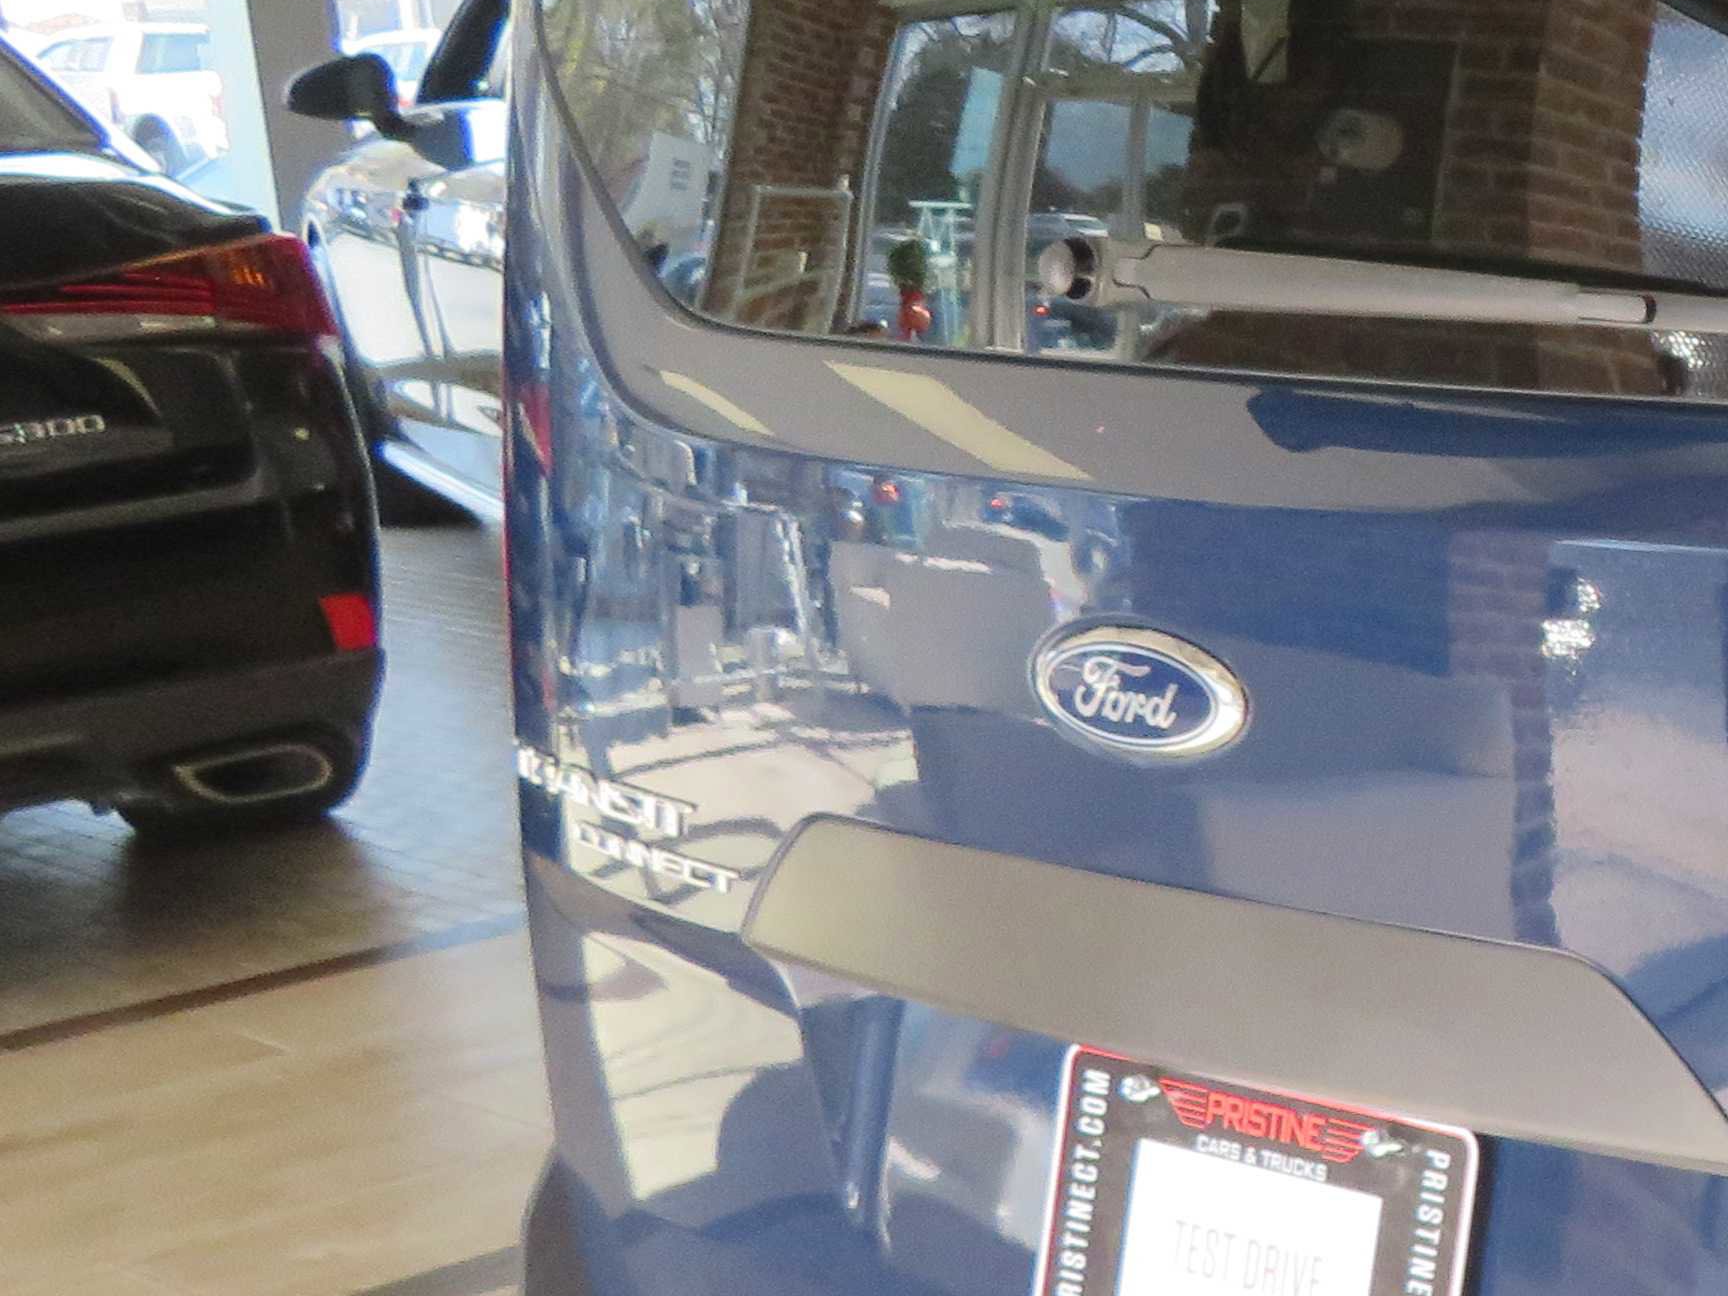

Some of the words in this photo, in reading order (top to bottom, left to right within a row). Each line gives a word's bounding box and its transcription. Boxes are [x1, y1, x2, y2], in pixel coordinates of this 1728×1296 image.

[1072, 655, 1179, 730] Ford
[576, 821, 741, 894] CONNECT
[1205, 1090, 1328, 1151] PRISTINE
[1196, 1133, 1242, 1162] CARS
[1244, 1145, 1257, 1166] &
[1260, 1148, 1328, 1183] TRUCKS
[1174, 1218, 1238, 1281] TEST
